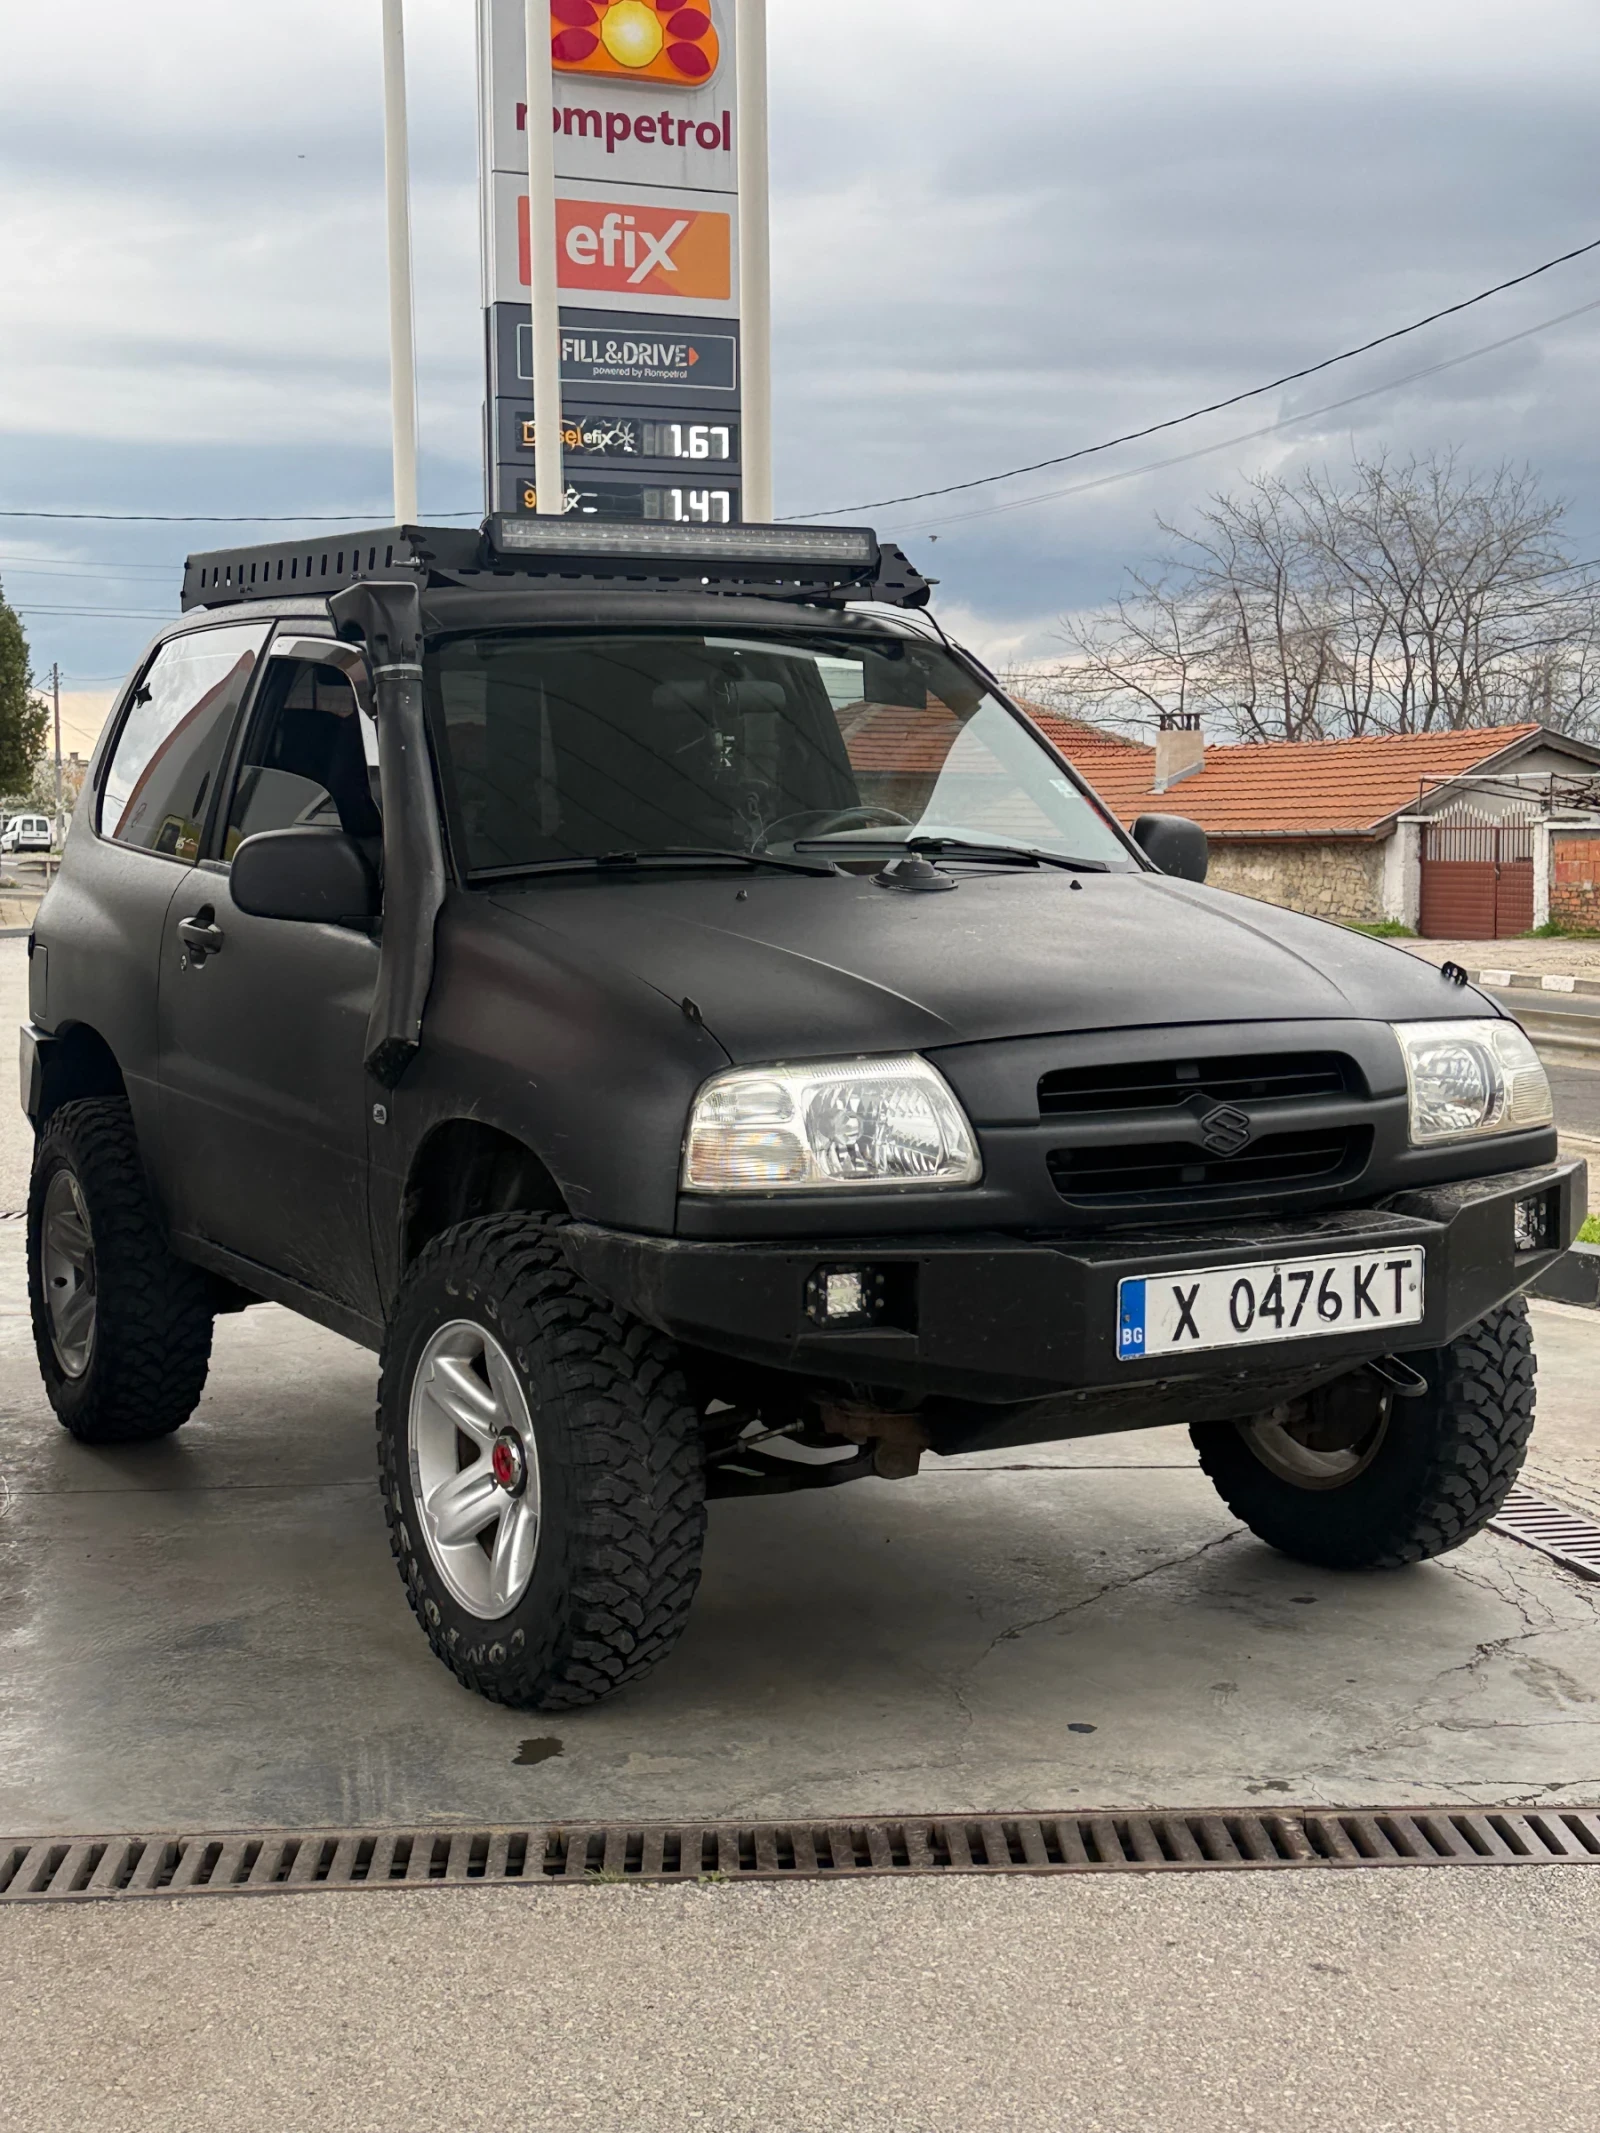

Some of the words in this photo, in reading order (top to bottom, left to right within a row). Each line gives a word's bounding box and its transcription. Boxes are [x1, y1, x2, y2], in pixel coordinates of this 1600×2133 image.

[565, 212, 689, 284] efix
[561, 338, 688, 367] FILL&DRIVE
[593, 366, 630, 376] powered
[632, 367, 643, 378] by
[644, 367, 688, 379] Rompetrol
[671, 424, 729, 459] 1.67
[671, 488, 729, 522] 1.47
[1122, 1328, 1143, 1345] BG
